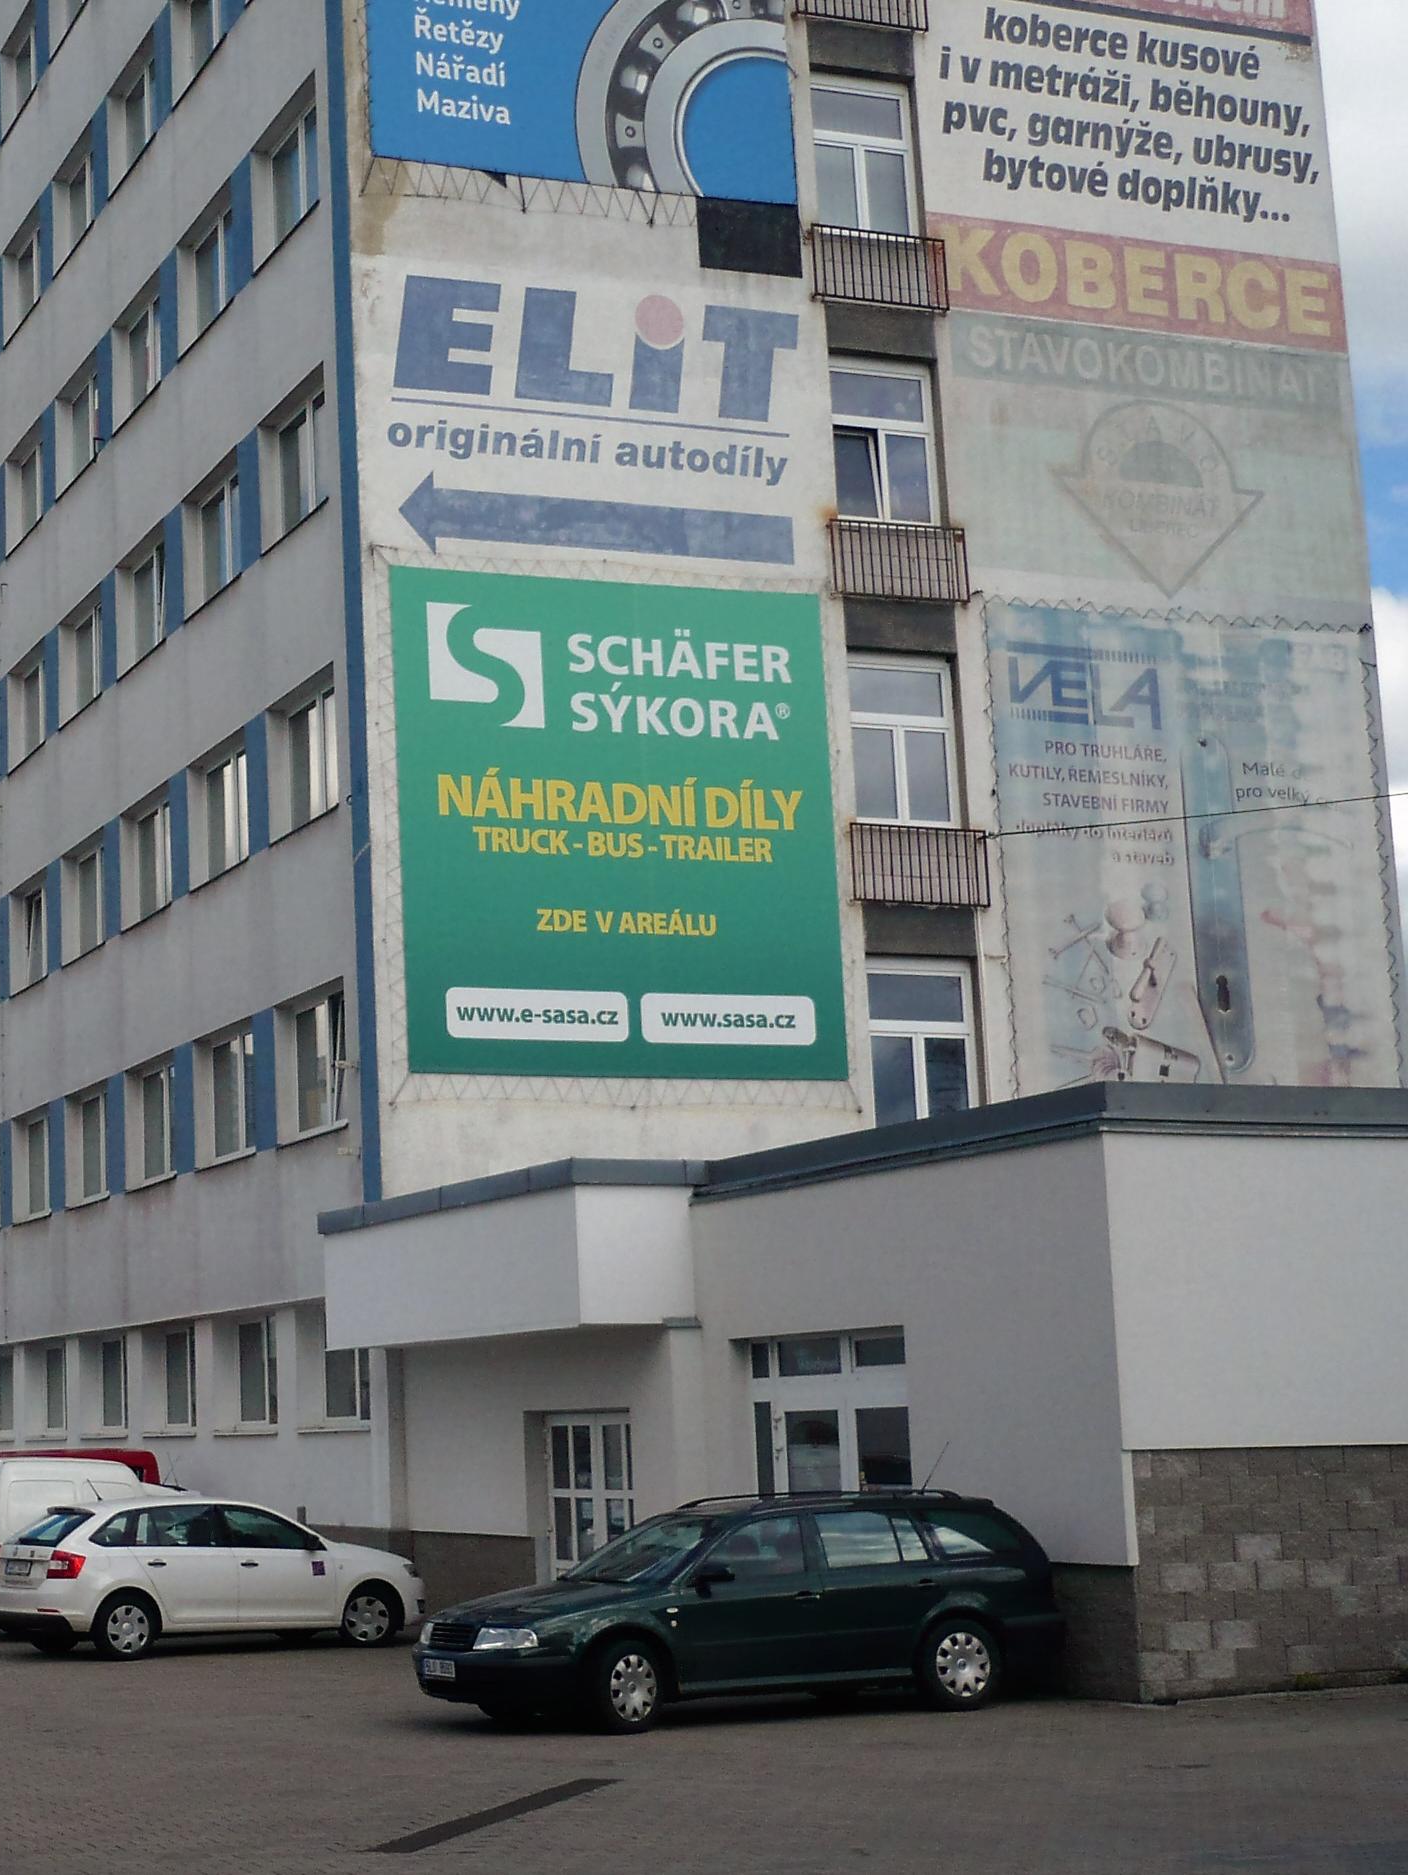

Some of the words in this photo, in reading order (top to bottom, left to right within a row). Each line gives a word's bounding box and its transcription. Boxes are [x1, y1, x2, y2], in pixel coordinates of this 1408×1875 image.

[414, 6, 504, 54] Řetězy
[983, 6, 1129, 60] koberce
[1136, 31, 1261, 80] kusové
[415, 51, 506, 87] Nářadí
[939, 46, 952, 80] i
[960, 55, 982, 84] v
[989, 58, 1140, 112] metráži,
[1149, 79, 1310, 137] běhouny,
[417, 88, 511, 125] Maziva
[942, 100, 1017, 142] pvc,
[1028, 112, 1183, 165] garnýže,
[1193, 134, 1319, 185] ubrusy,
[982, 148, 1109, 197] bytové
[1118, 168, 1291, 223] doplňky...
[946, 223, 1331, 338] KOBERCE
[387, 419, 601, 464] originální
[614, 440, 789, 486] autodíly
[566, 628, 792, 684] SCHÄFER
[1007, 655, 1163, 731] VELA
[1008, 762, 1066, 782] KUTILY,
[1045, 739, 1077, 757] PRO
[437, 767, 698, 827] NÁHRADNÍ
[704, 779, 804, 831] DÍLY
[1042, 792, 1118, 811] STAVEBNÍ
[1122, 799, 1170, 815] FIRMY
[1235, 787, 1263, 802] pro
[472, 825, 570, 855] TRUCK
[587, 830, 644, 858] BUS
[659, 834, 773, 863] TRAILER
[536, 908, 588, 933] ZDE
[595, 910, 614, 934] V
[618, 908, 718, 937] AREÁLU
[456, 1004, 620, 1027] www.e-sasa.cz
[661, 1008, 797, 1030] www.sasa.cz
